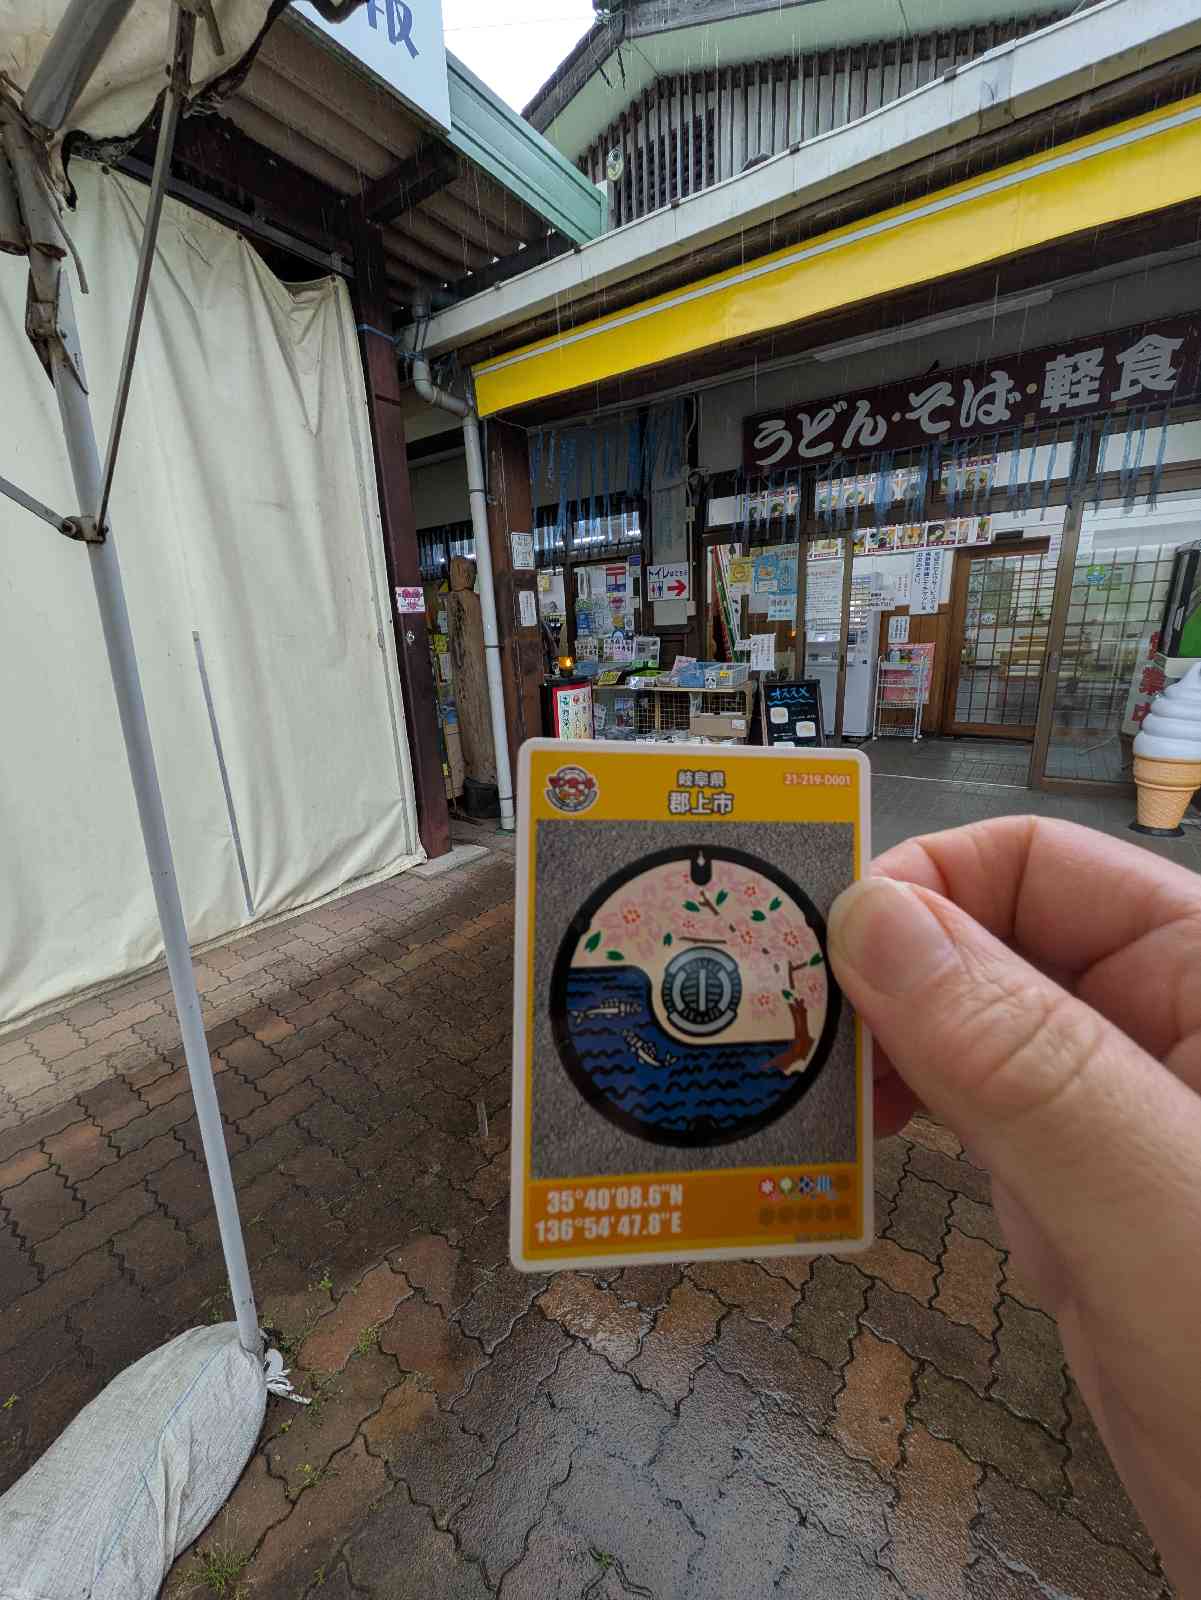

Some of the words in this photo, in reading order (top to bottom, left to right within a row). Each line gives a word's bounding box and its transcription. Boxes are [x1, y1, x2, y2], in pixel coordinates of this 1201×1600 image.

[753, 334, 1184, 466] うどん・そば・軽食
[678, 770, 725, 788] 岐阜県
[784, 774, 850, 785] 21-219-D001
[669, 791, 734, 815] 郡上市
